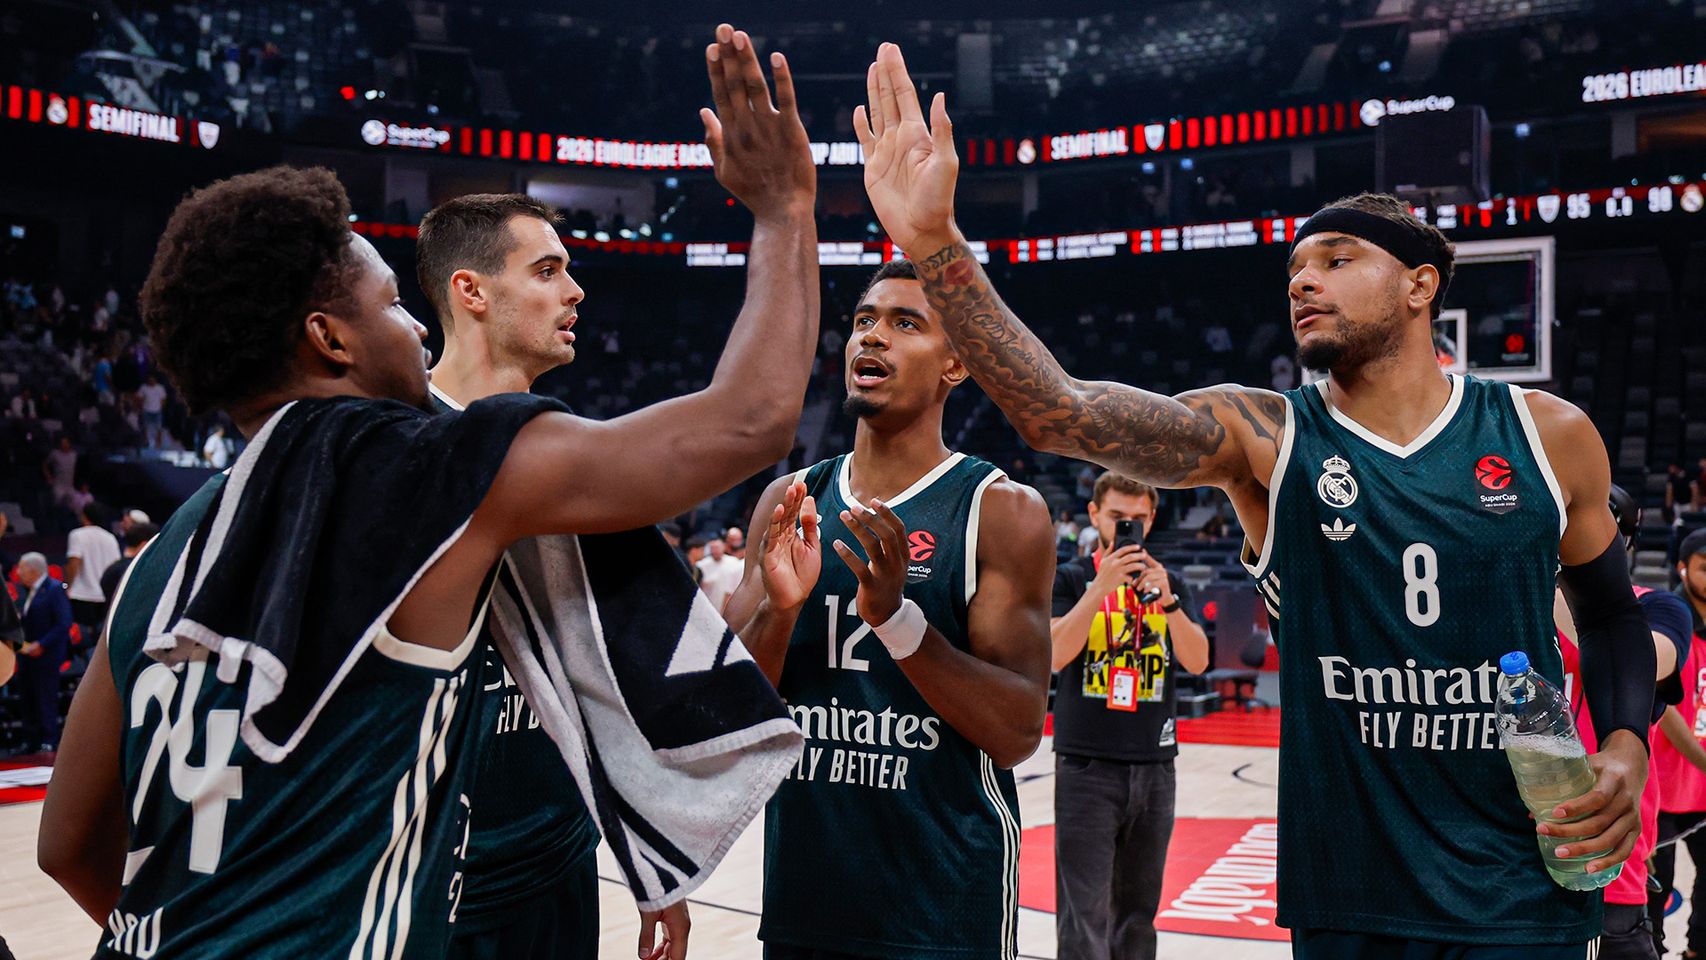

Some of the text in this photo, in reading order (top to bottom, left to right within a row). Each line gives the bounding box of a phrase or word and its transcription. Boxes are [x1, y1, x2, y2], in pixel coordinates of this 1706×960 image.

[1387, 95, 1455, 115] SuperCup
[1582, 72, 1629, 102] 2026
[89, 104, 180, 143] SEMIFINAL
[387, 124, 450, 144] SuperCup
[595, 140, 677, 166] EUROLEAGUE
[1051, 130, 1129, 160] SEMIFINAL
[1567, 193, 1591, 219] 95
[1480, 493, 1518, 503] SuperCup
[1402, 542, 1441, 627] 8
[825, 594, 873, 672] 12
[1087, 650, 1163, 690] KMP
[1317, 655, 1506, 706] Emirat
[787, 697, 941, 751] mirates
[1359, 711, 1506, 750] FLY BETTE
[121, 660, 244, 888] 24
[785, 748, 910, 791] LY BETTER
